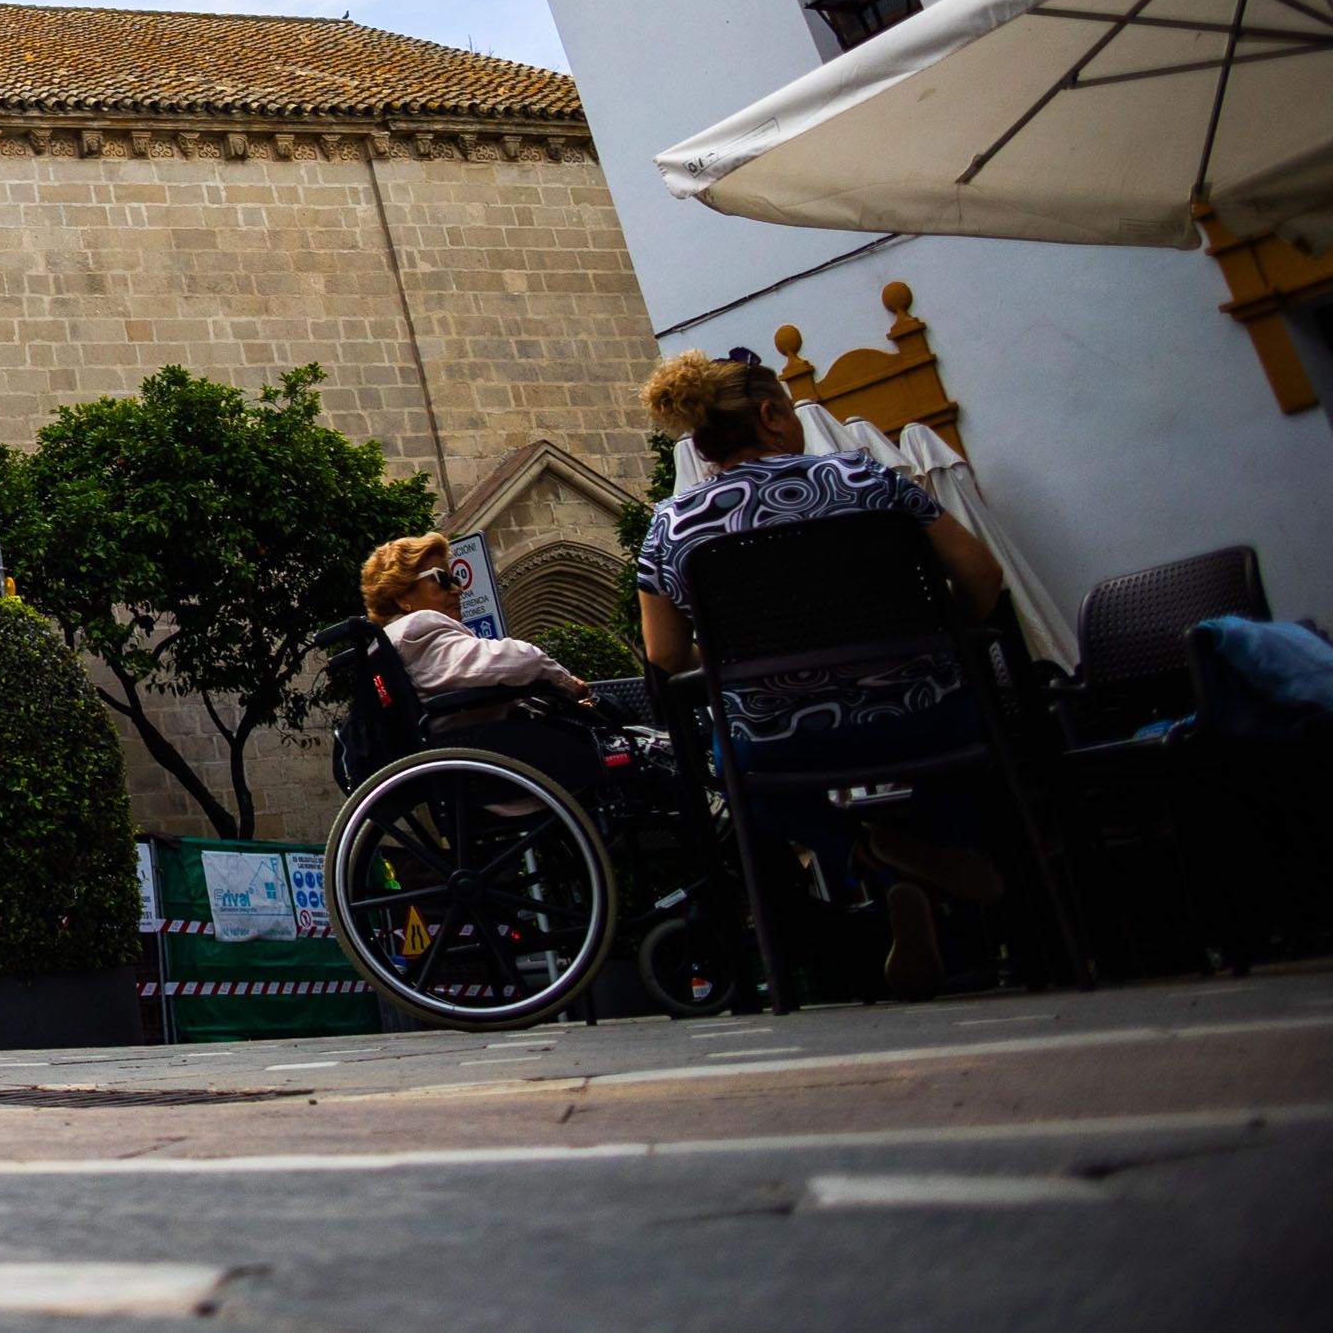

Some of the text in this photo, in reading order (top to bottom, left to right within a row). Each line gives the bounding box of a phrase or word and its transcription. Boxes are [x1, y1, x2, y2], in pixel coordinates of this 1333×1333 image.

[451, 543, 477, 558] NCION!
[461, 589, 475, 600] ONA
[463, 606, 486, 619] ATONES
[214, 888, 251, 907] Frival
